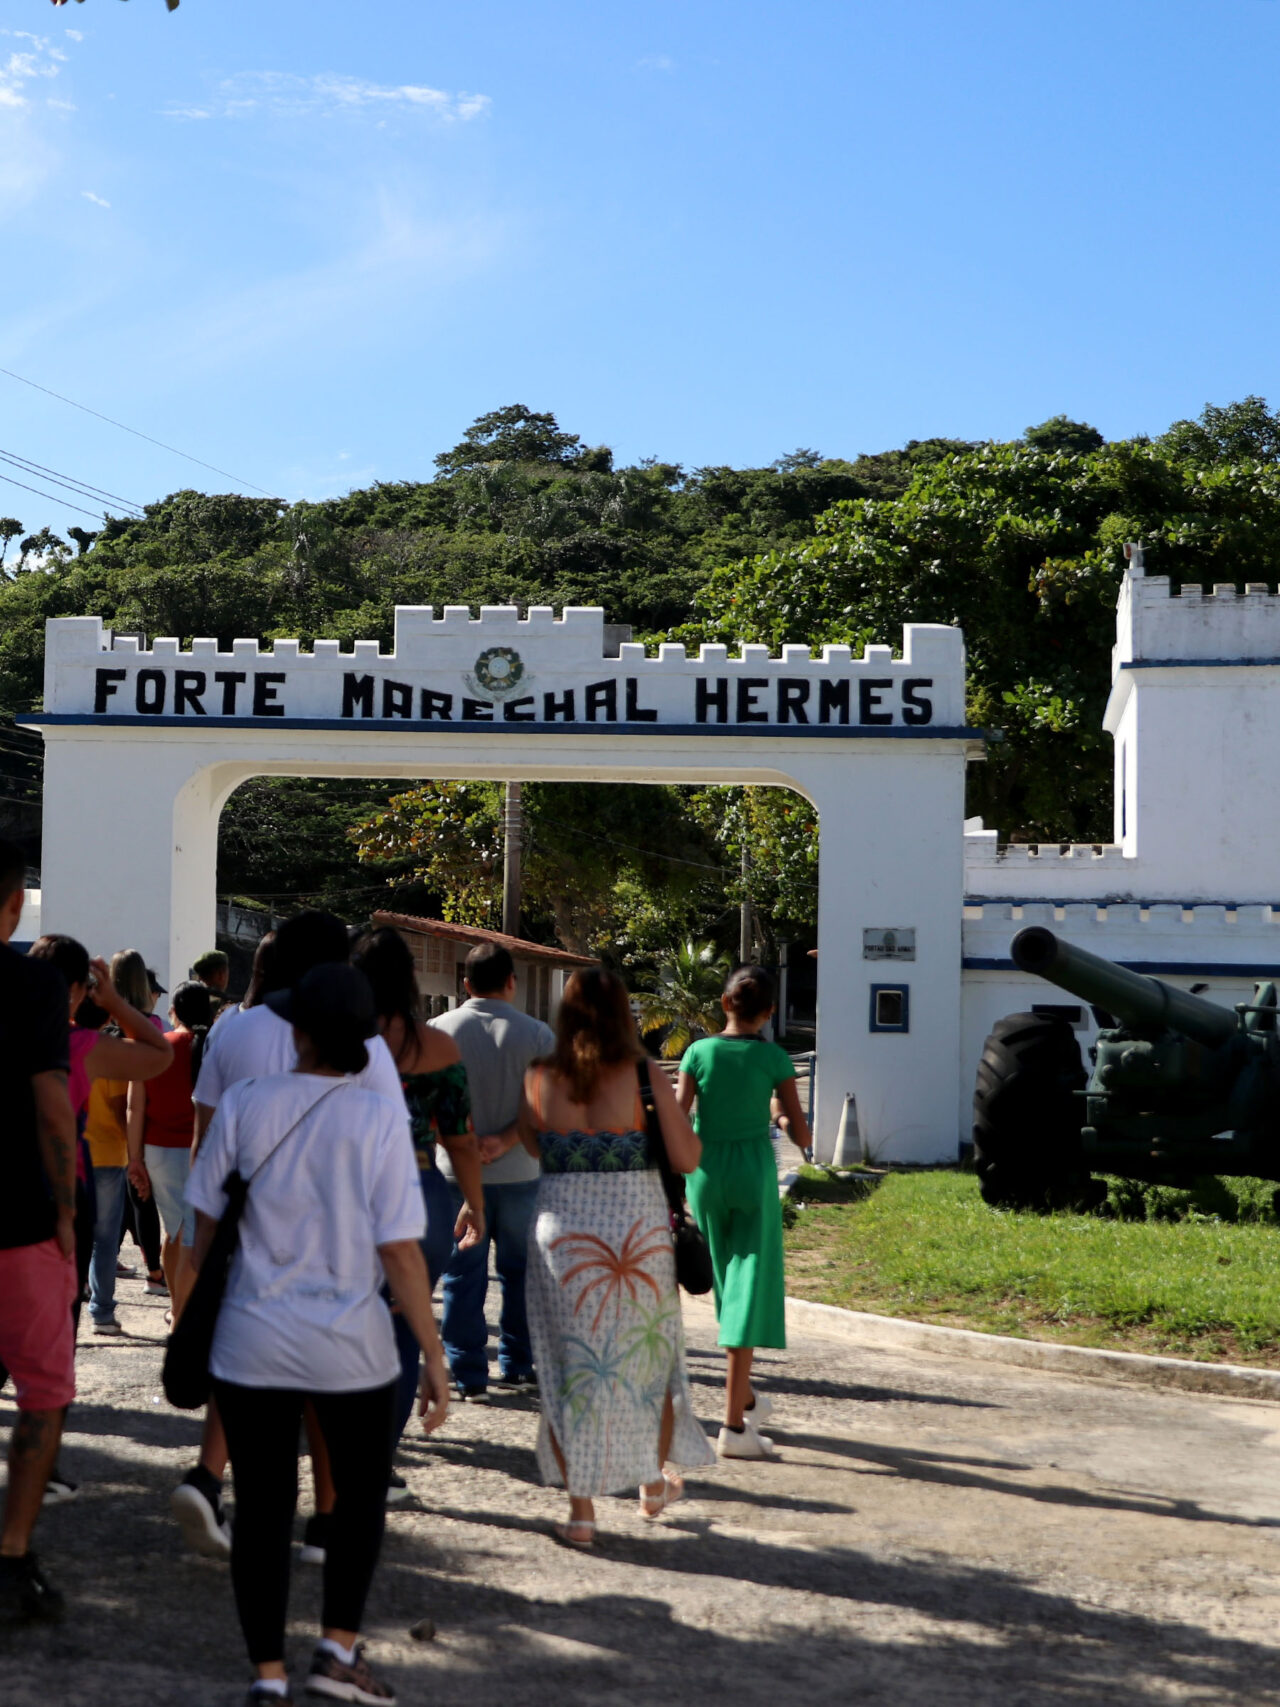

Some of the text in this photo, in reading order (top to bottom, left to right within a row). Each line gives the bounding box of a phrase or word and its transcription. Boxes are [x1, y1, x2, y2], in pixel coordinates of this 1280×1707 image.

[93, 668, 933, 726] FORTE MARECHAL HERMES
